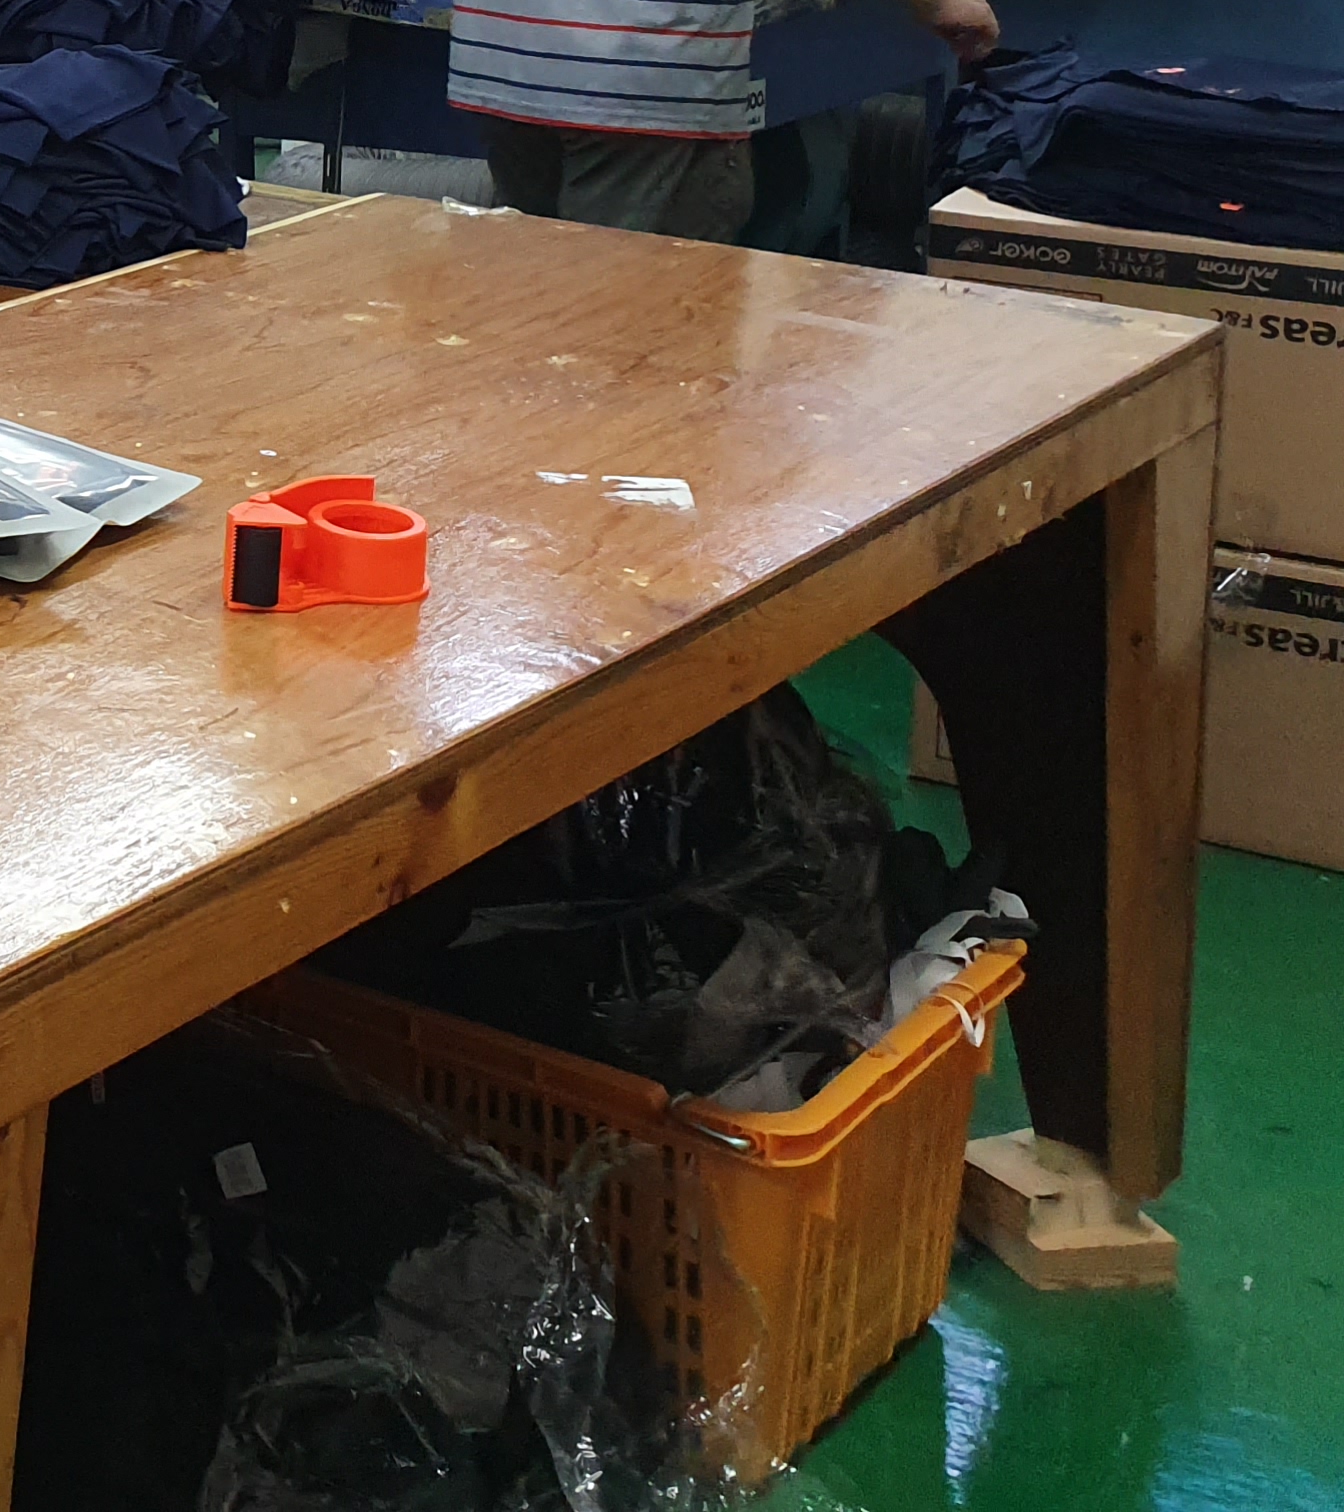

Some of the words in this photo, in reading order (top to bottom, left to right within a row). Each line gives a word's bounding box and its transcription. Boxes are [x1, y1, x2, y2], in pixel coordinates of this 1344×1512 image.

[1097, 247, 1166, 266] GATES
[1096, 260, 1165, 279] PEARLY
[1243, 623, 1344, 663] reas
